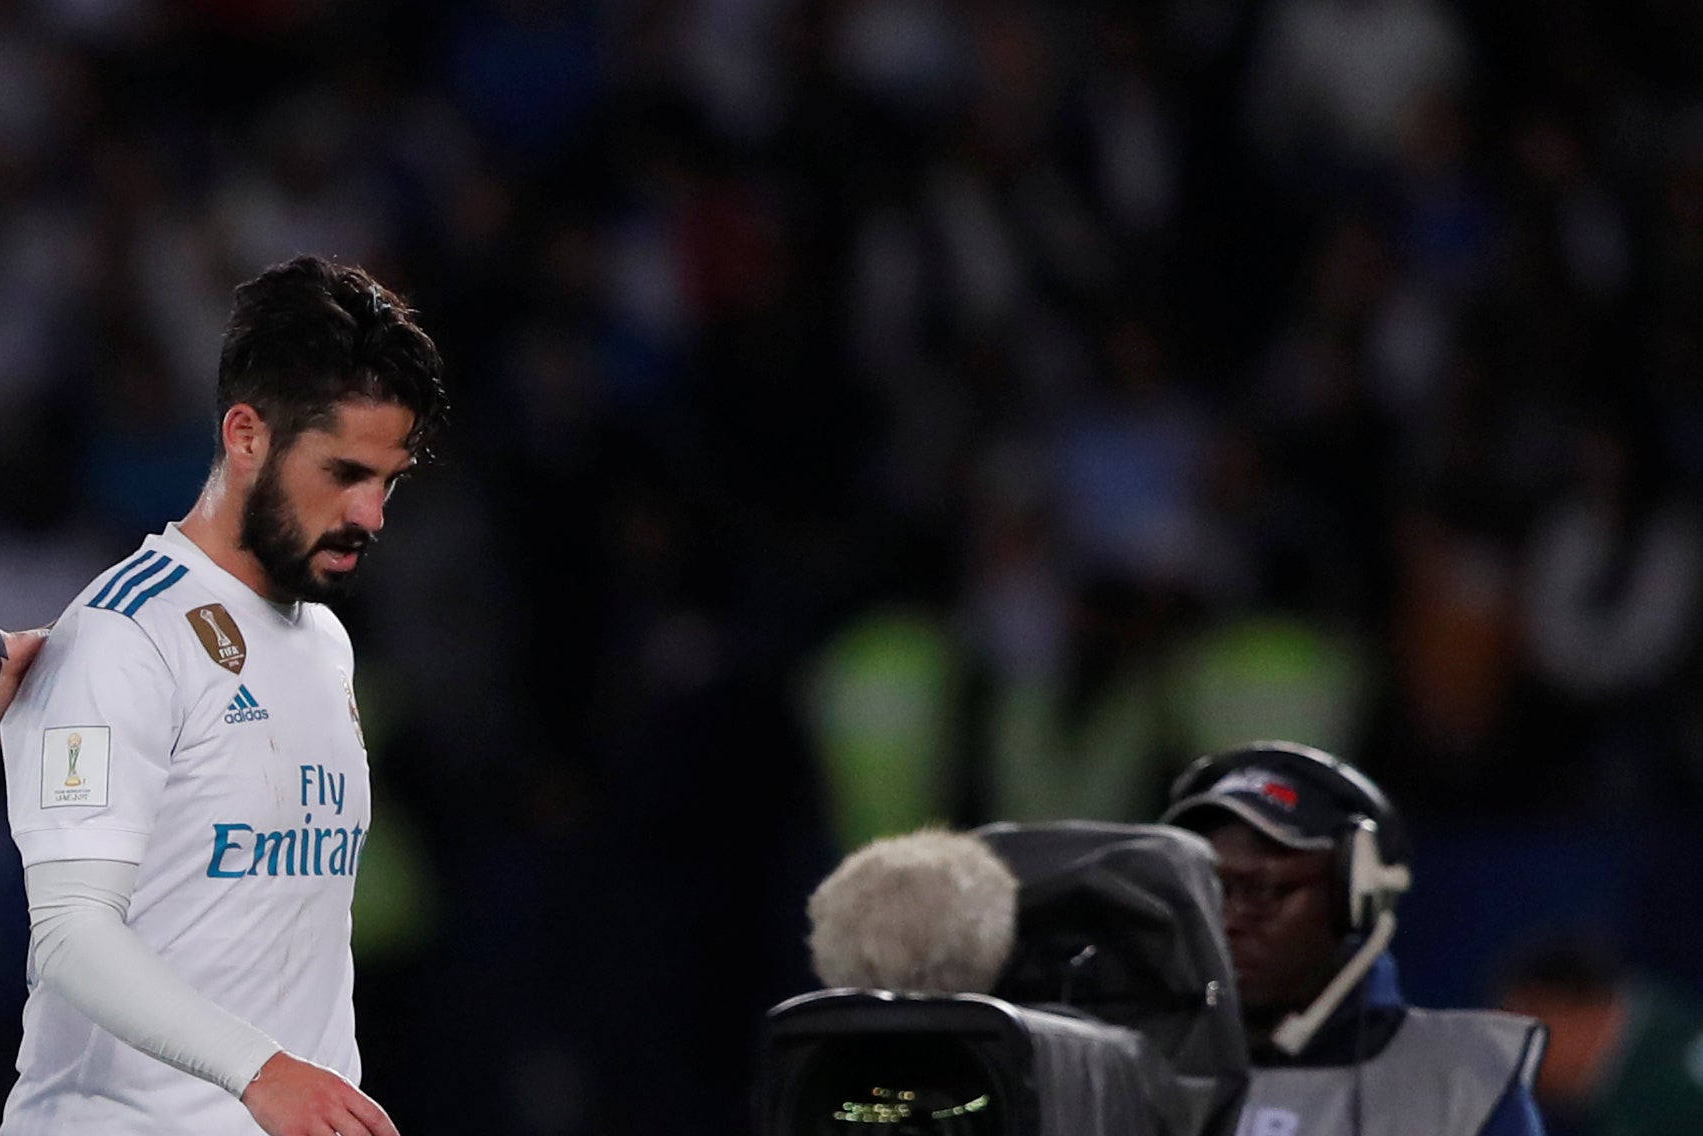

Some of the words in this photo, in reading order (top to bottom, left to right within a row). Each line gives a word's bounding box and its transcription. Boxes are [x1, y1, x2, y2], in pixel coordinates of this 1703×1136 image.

[218, 646, 240, 658] FIFA
[224, 708, 269, 724] adidas
[300, 765, 345, 815] Fly
[206, 813, 367, 878] Emirat
